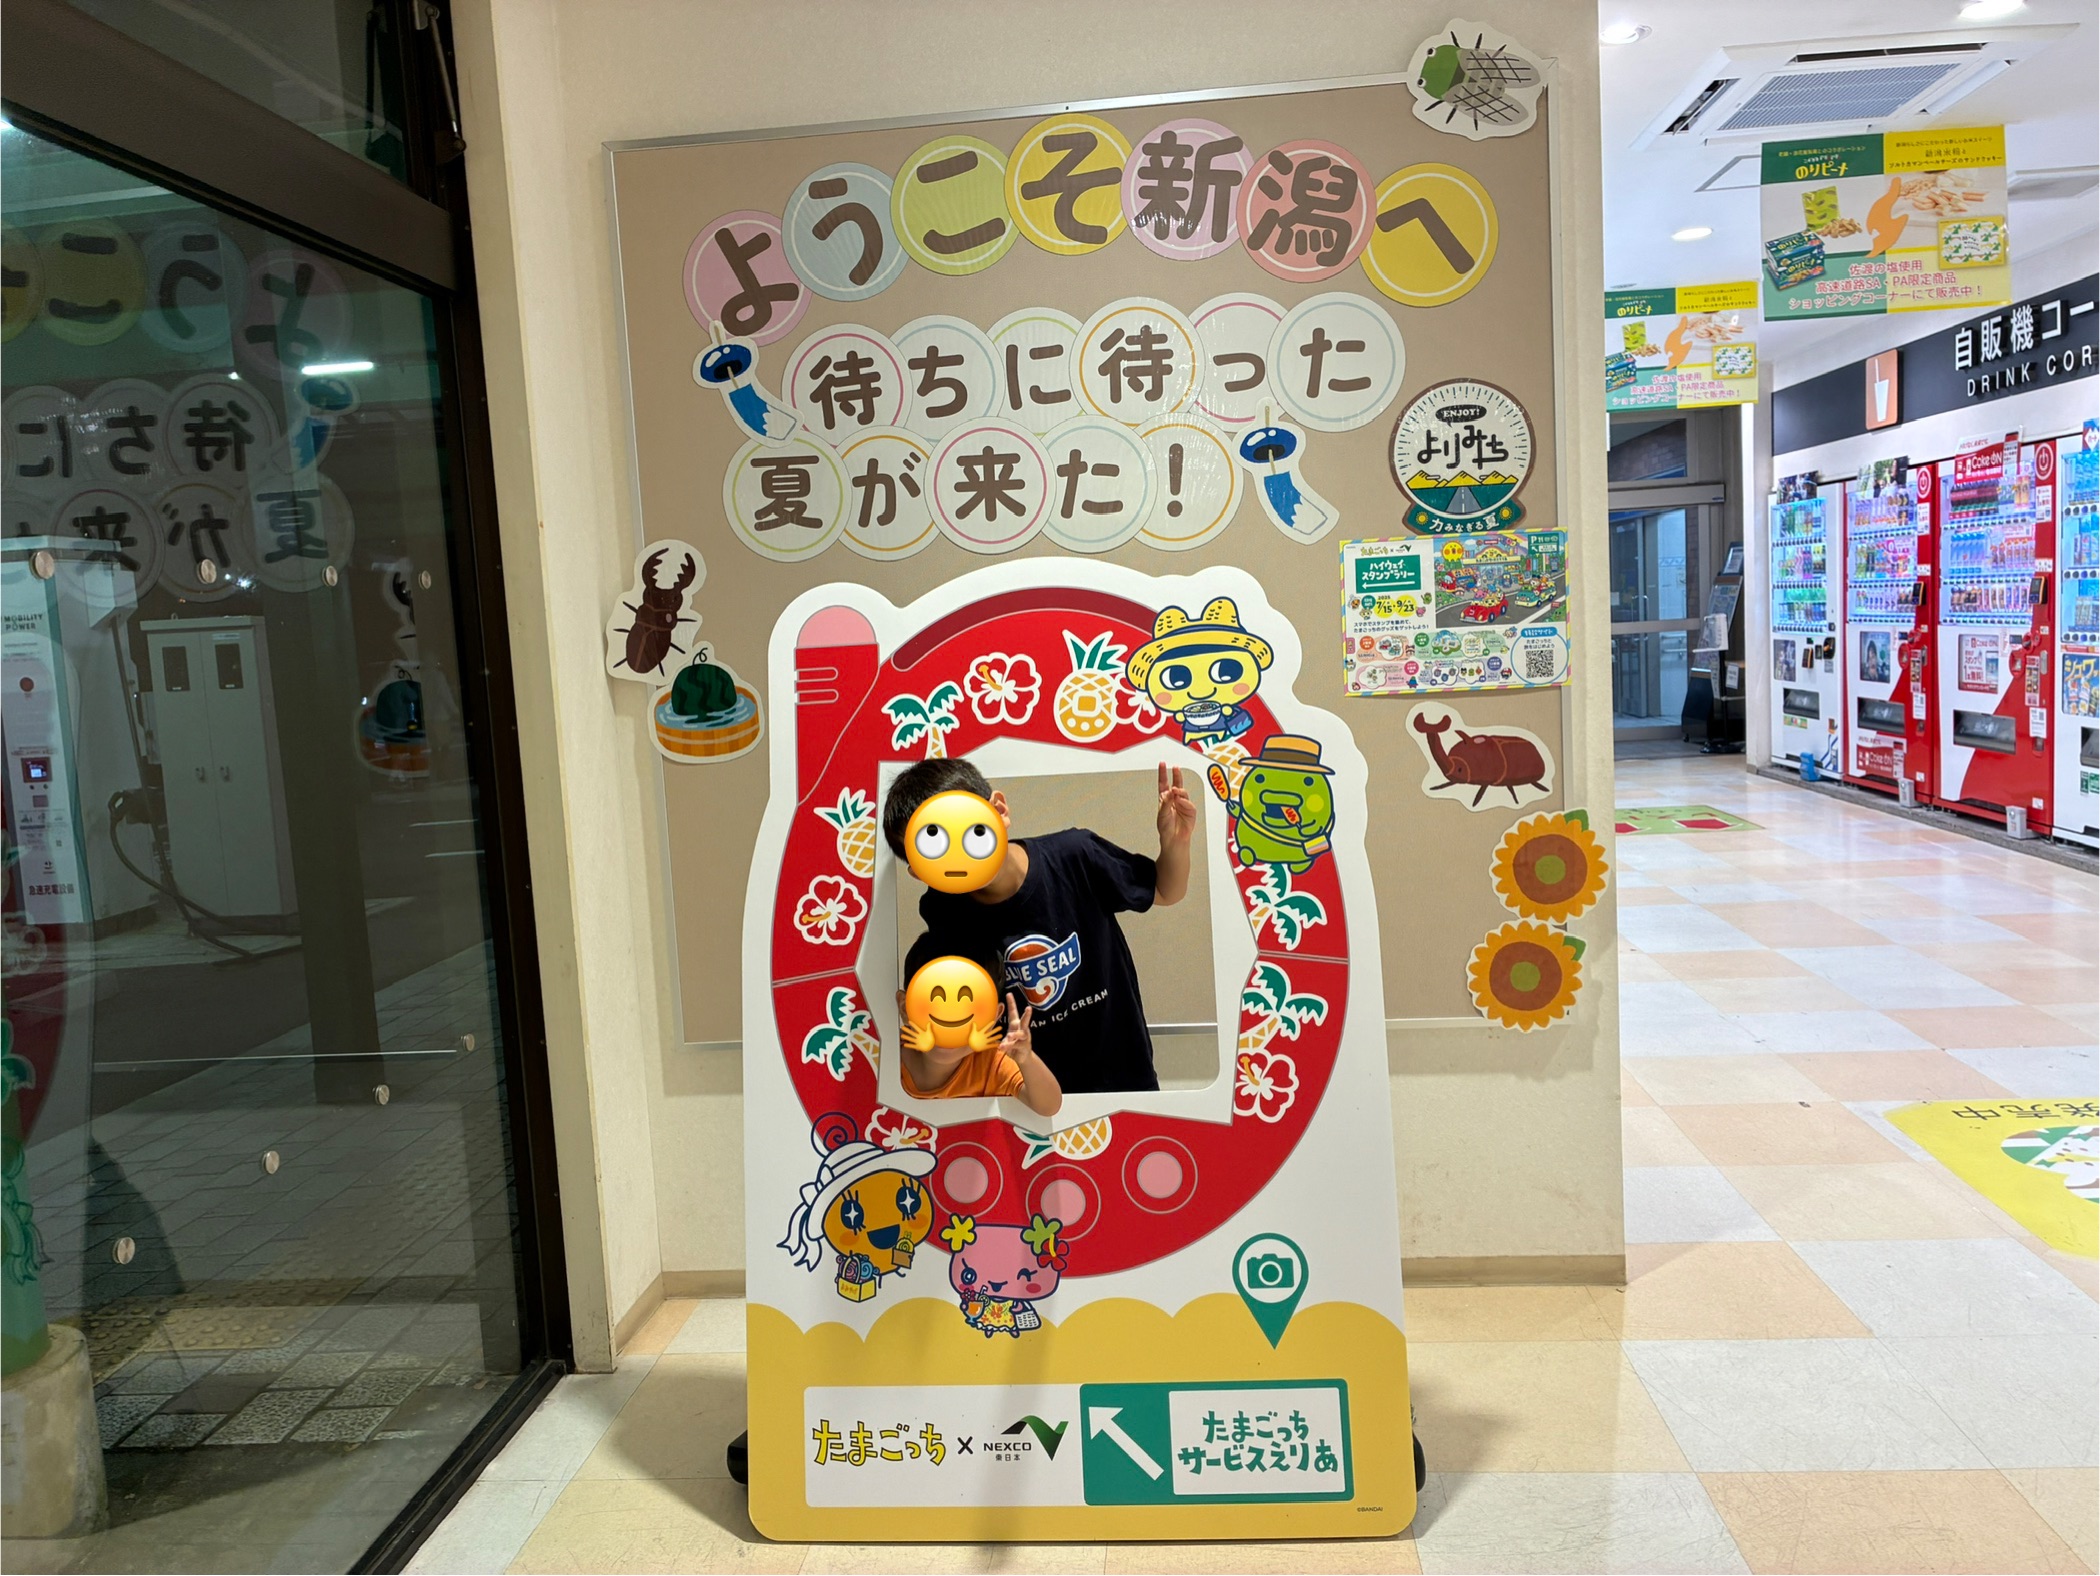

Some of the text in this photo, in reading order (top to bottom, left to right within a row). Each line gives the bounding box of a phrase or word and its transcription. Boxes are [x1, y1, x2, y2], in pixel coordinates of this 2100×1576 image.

[715, 130, 1475, 336] ようこそ新潟へ
[1848, 259, 1923, 276] 佐渡の塩使用
[1815, 271, 1957, 294] 高速道路SA・PA限定商品
[1955, 299, 2095, 371] 自販機コー
[810, 325, 1373, 430] 待ちに待った
[1967, 344, 2093, 397] DRINK COR
[1442, 407, 1481, 419] ENJOY!
[1416, 424, 1510, 471] よりみち
[750, 445, 1185, 531] 夏が来た！
[1429, 512, 1500, 533] 力みなぎる夏
[1361, 569, 1416, 580] スタンプラリー
[1369, 558, 1405, 570] ハイウェイ
[6, 622, 36, 631] POWER
[1036, 947, 1077, 976] SEAL
[1202, 1409, 1310, 1444] たまごっち
[811, 1418, 947, 1467] たまごっち
[983, 1441, 1032, 1453] NEXCO
[1177, 1438, 1339, 1475] サービスえりあ
[995, 1453, 1021, 1462] 東日本
